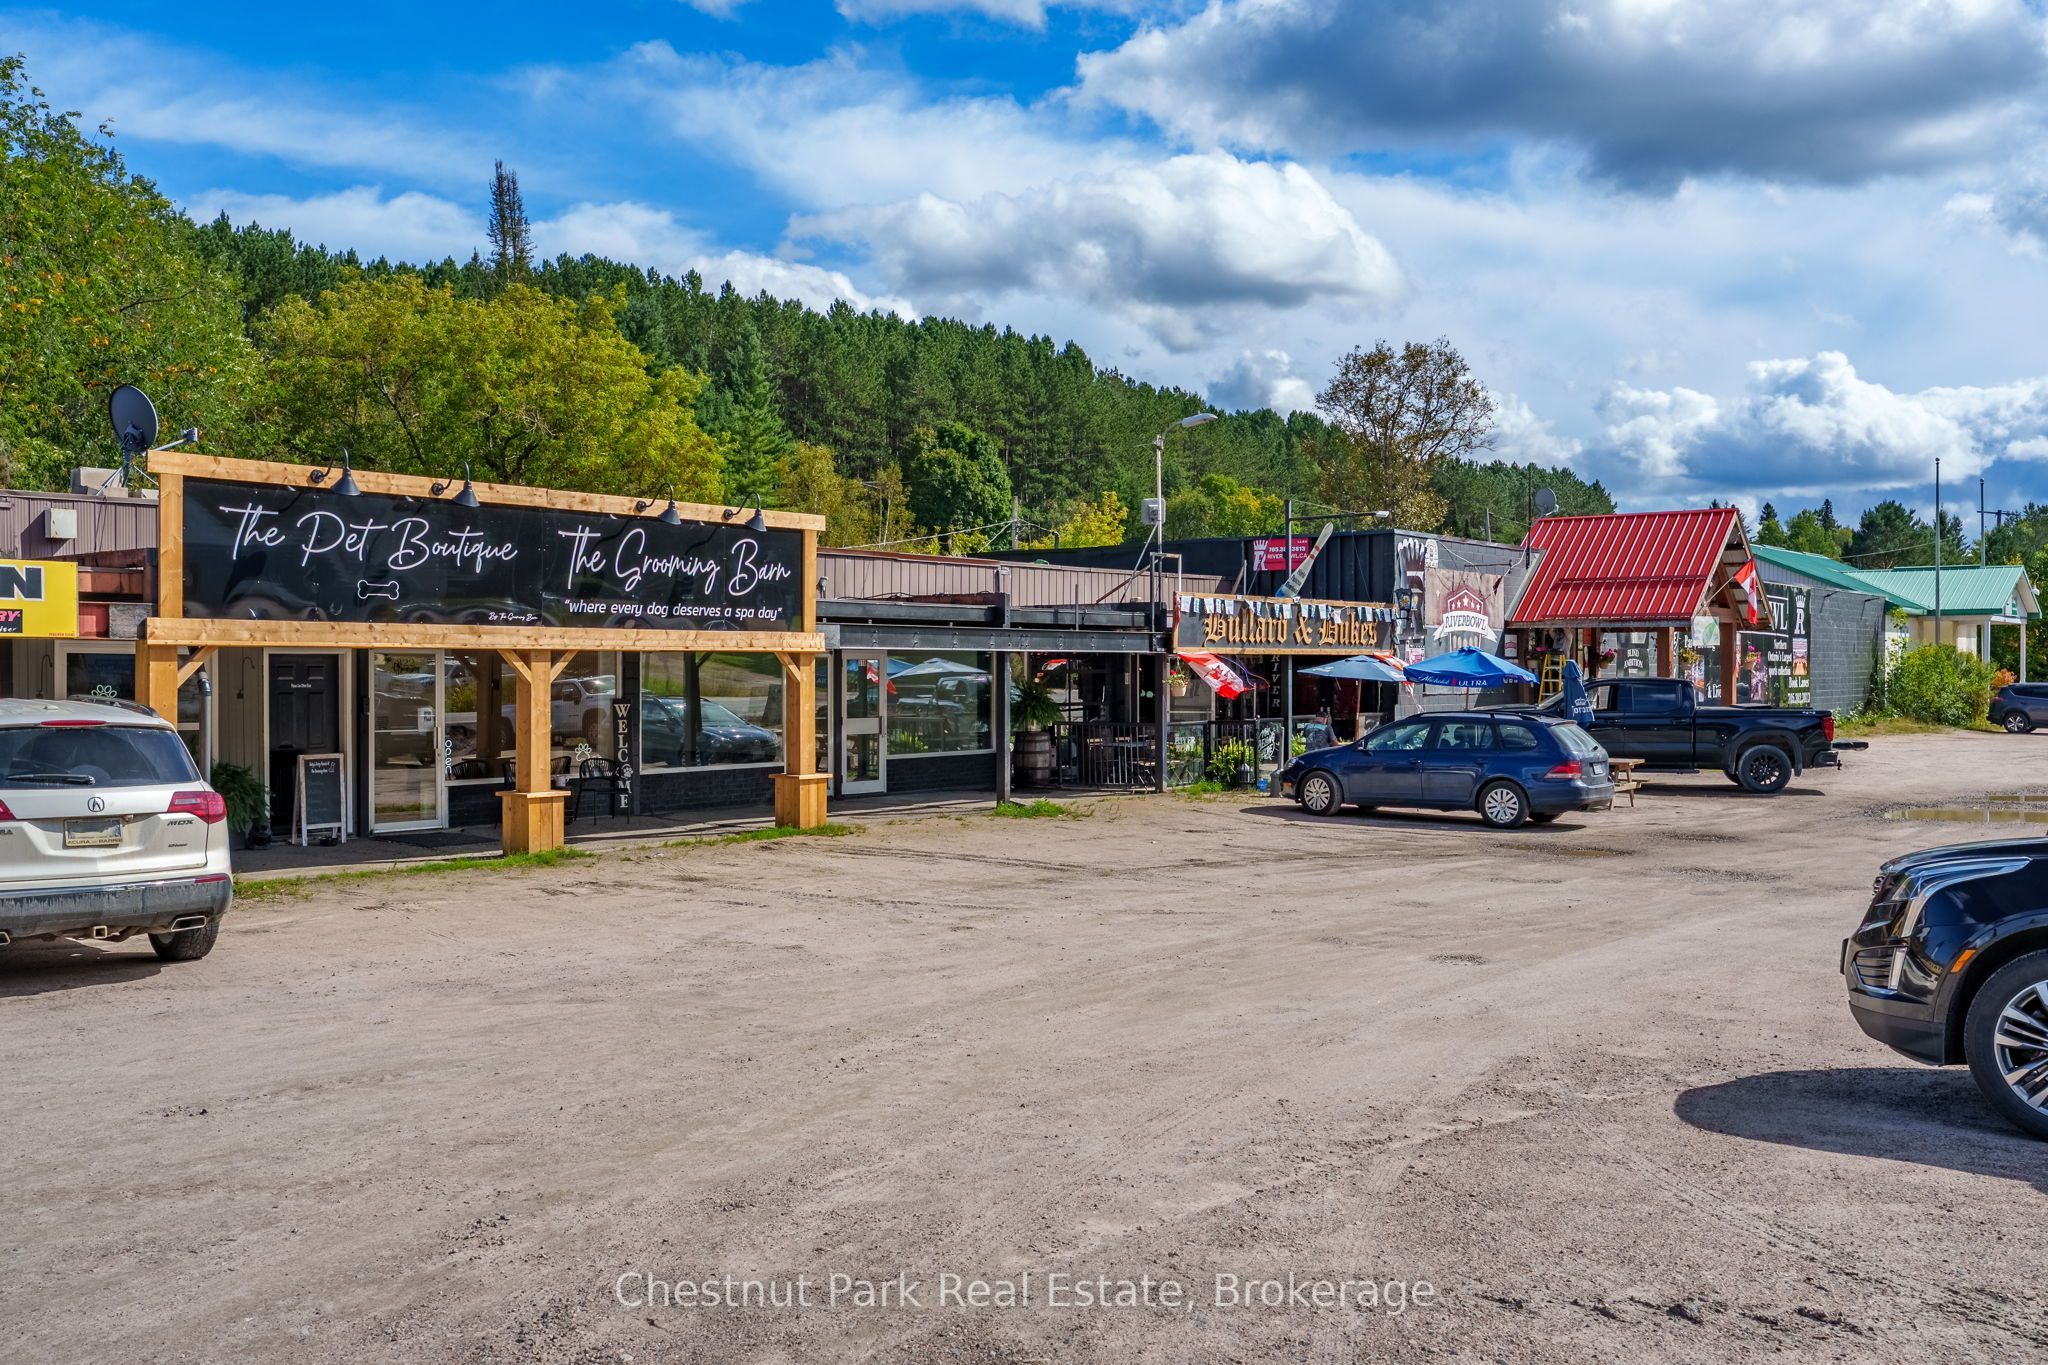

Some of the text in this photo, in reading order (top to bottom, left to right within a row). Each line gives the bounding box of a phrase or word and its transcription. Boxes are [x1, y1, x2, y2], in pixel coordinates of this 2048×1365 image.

[219, 502, 519, 574] The Pet Boutique
[558, 524, 792, 596] The Grooming Barn
[610, 603, 643, 617] every
[647, 602, 668, 618] dog
[673, 603, 721, 618] deserves
[724, 608, 731, 618] a
[735, 608, 754, 621] spa
[1445, 615, 1486, 631] RIVERBOWL
